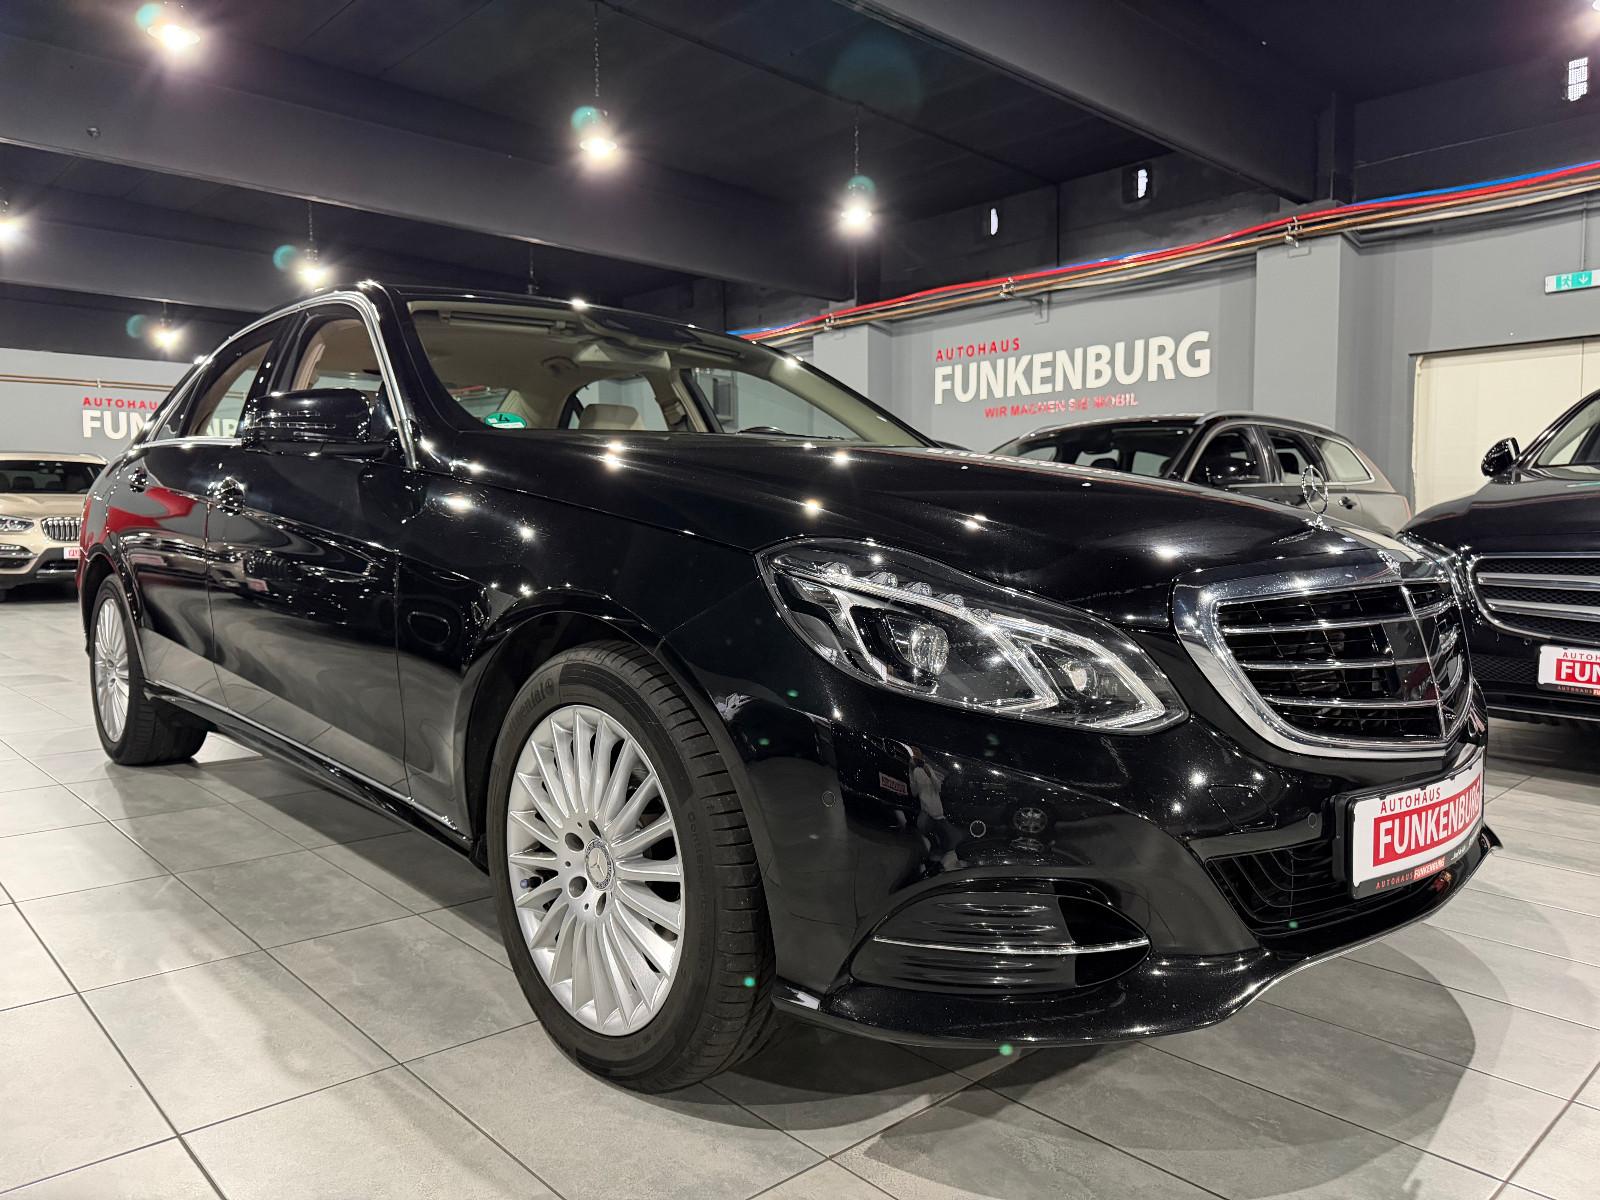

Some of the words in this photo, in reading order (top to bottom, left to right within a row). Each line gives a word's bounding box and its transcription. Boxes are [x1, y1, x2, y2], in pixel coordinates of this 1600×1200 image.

[935, 337, 1021, 362] AUTOHAUS
[934, 330, 1211, 405] FUNKENBURG
[82, 397, 158, 409] AUTOHAU
[984, 405, 1007, 418] WIR
[1010, 399, 1066, 416] MACHEN
[82, 409, 153, 440] FUN
[1562, 651, 1600, 662] AUTOH
[1560, 661, 1600, 683] FUN
[1380, 787, 1441, 814] AUTOHAUS
[1378, 778, 1481, 860] FUNKENBURG
[1376, 873, 1413, 890] AUTOHAUS
